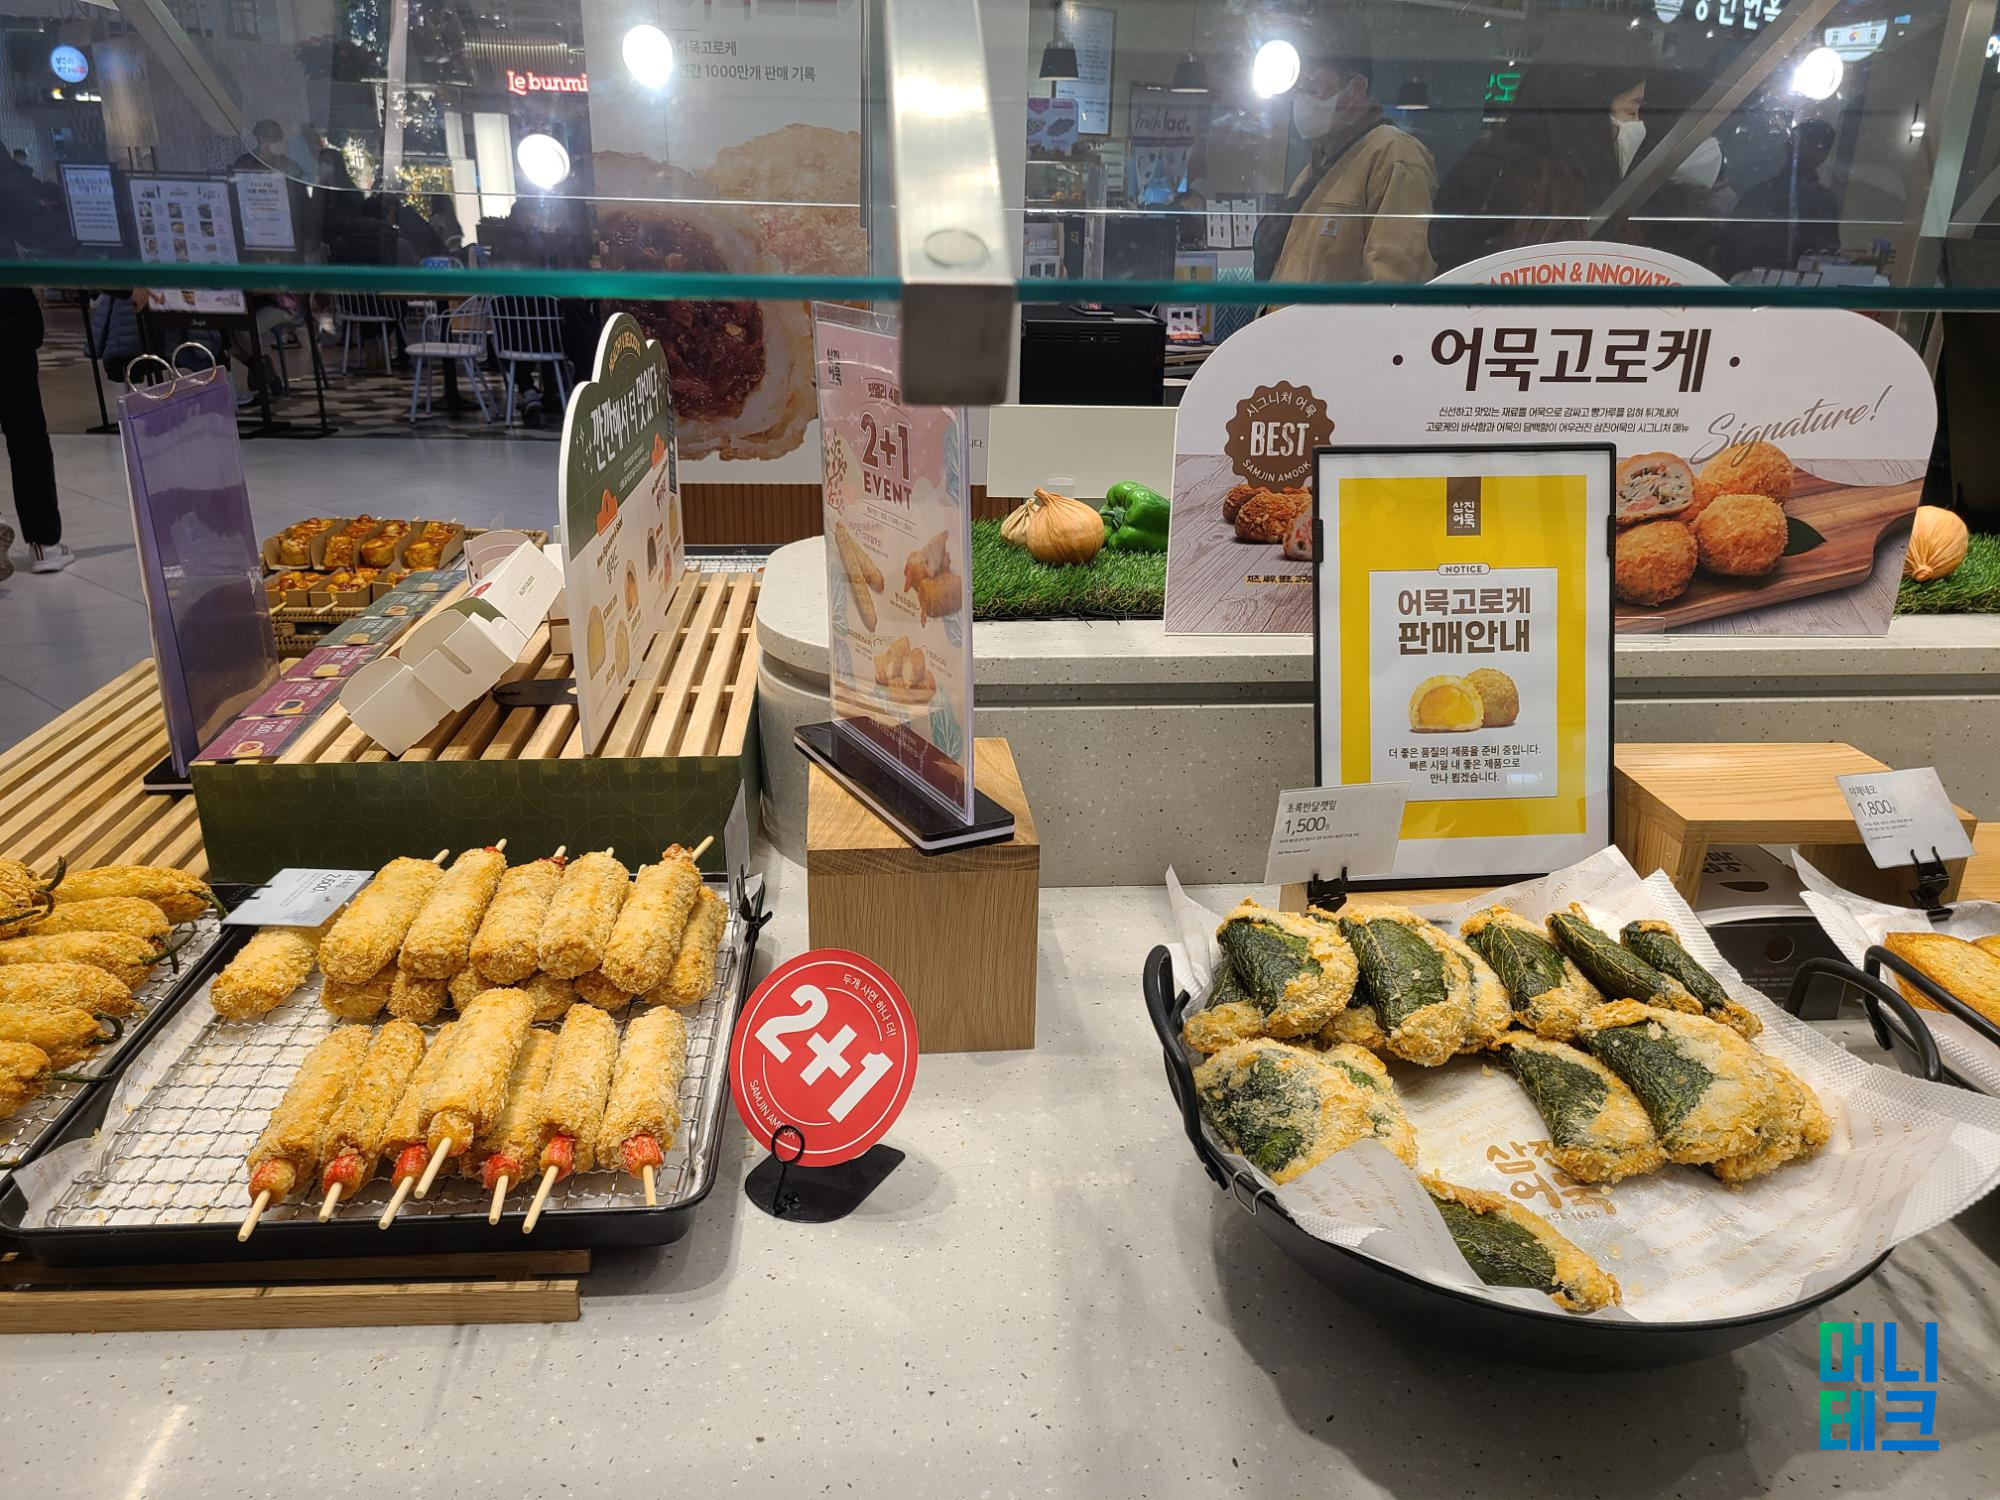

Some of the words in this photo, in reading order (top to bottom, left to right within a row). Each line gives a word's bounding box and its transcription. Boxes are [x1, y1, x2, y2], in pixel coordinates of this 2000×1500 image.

[507, 69, 527, 96] Le
[704, 64, 762, 81] 1000만개
[764, 65, 789, 82] 판매
[791, 66, 817, 83] 기록
[1569, 262, 1582, 283] &
[1431, 327, 1713, 393] 어묵고로케
[629, 387, 639, 435] 더
[635, 361, 660, 432] 맛있다
[1246, 391, 1293, 418] 시그니처
[1295, 396, 1318, 419] 어묵
[1474, 407, 1500, 418] 맛있는
[1501, 407, 1527, 418] 재료를
[1528, 407, 1562, 418] 어묵으로
[1250, 421, 1310, 457] BEST
[1425, 422, 1459, 433] 고로케의
[1496, 422, 1521, 433] 어묵의
[1558, 422, 1592, 433] 어우러진
[1593, 422, 1635, 433] 삼진어묵의
[1636, 422, 1671, 433] 시그니처
[1672, 422, 1689, 433] 메뉴
[1689, 385, 1893, 468] Signature!
[860, 411, 911, 482] 2+1
[1242, 459, 1276, 482] SAMJIN
[1278, 461, 1312, 482] AMOOK
[863, 470, 912, 510] EVENT
[1452, 500, 1475, 513] 삼진
[1452, 513, 1475, 528] 어묵
[1445, 564, 1483, 574] NOTICE
[1398, 587, 1531, 617] 어묵고로케
[1398, 620, 1530, 656] 판매안내
[1388, 748, 1398, 759] 더
[1400, 747, 1418, 758] 좋은
[1421, 747, 1449, 758] 품질의
[1450, 745, 1479, 757] 제품을
[1481, 744, 1500, 756] 준비
[1502, 743, 1541, 756] 중입니다.
[1409, 760, 1428, 771] 빠른
[1430, 759, 1448, 771] 시일
[1451, 759, 1460, 770] 내
[1463, 758, 1481, 770] 좋은
[1484, 757, 1521, 769] 제품으로
[1430, 772, 1448, 784] 만나
[1451, 771, 1500, 784] 뵙겠습니다.
[842, 973, 861, 991] 두개
[860, 985, 879, 1004] 사면
[875, 1001, 891, 1023] 하나
[886, 1022, 898, 1039] 더!
[754, 984, 894, 1123] 2+1
[749, 1078, 770, 1118] SAMJIN
